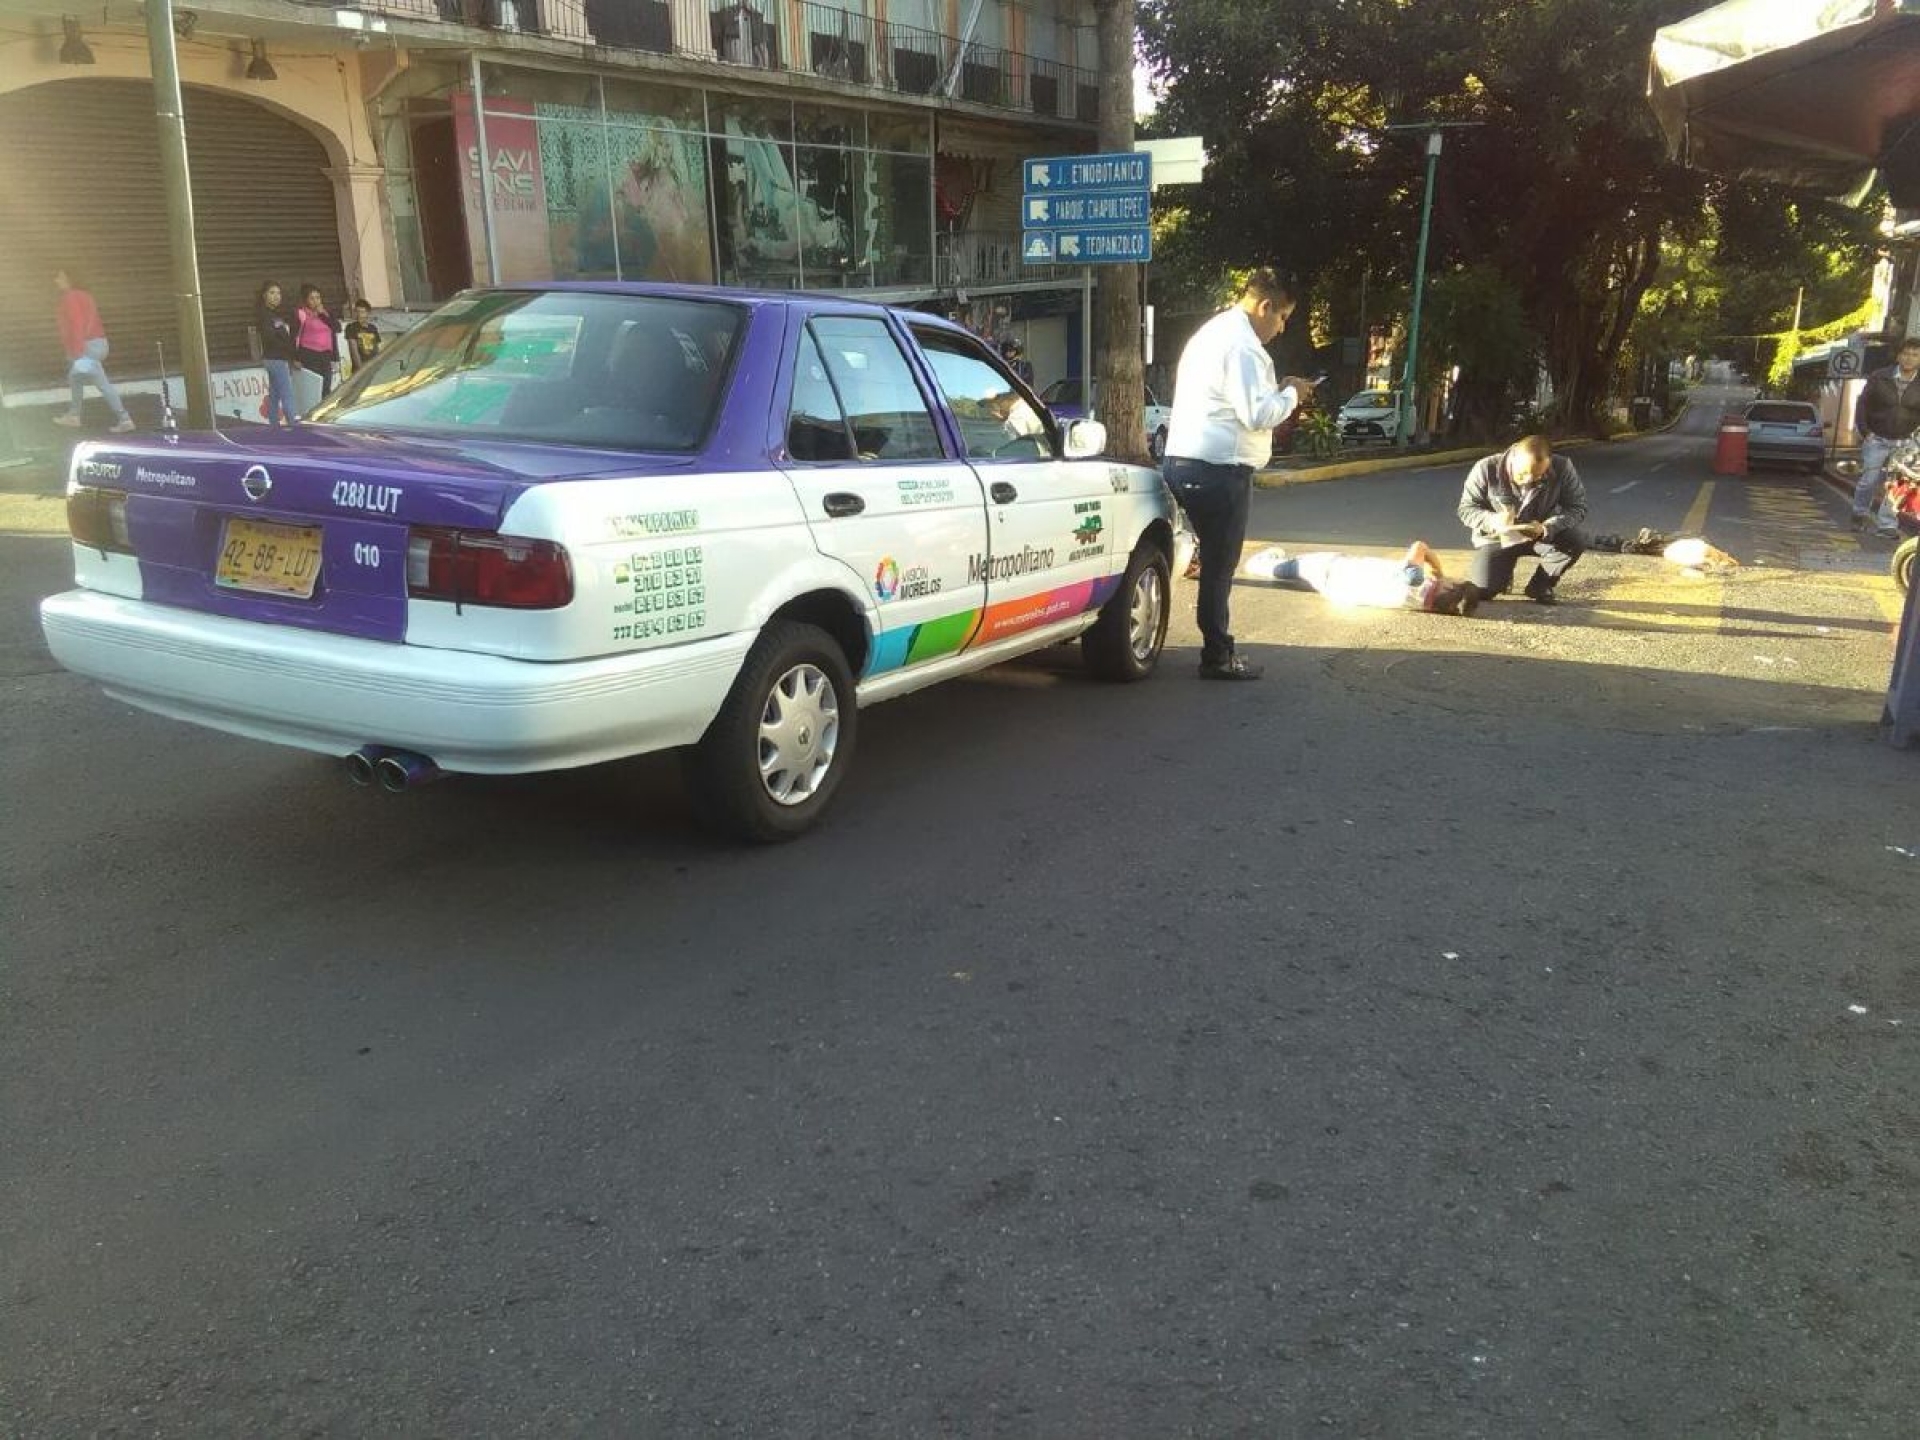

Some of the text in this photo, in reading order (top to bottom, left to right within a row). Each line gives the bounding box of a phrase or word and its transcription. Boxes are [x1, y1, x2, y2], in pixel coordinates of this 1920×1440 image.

[1071, 160, 1143, 185] ETNOBOTANICO
[1085, 234, 1143, 256] TEOPANZOLCO
[135, 466, 196, 487] Metropolitano
[354, 543, 380, 568] 010
[967, 544, 1055, 585] Metropolitano
[900, 577, 942, 600] MORELOS
